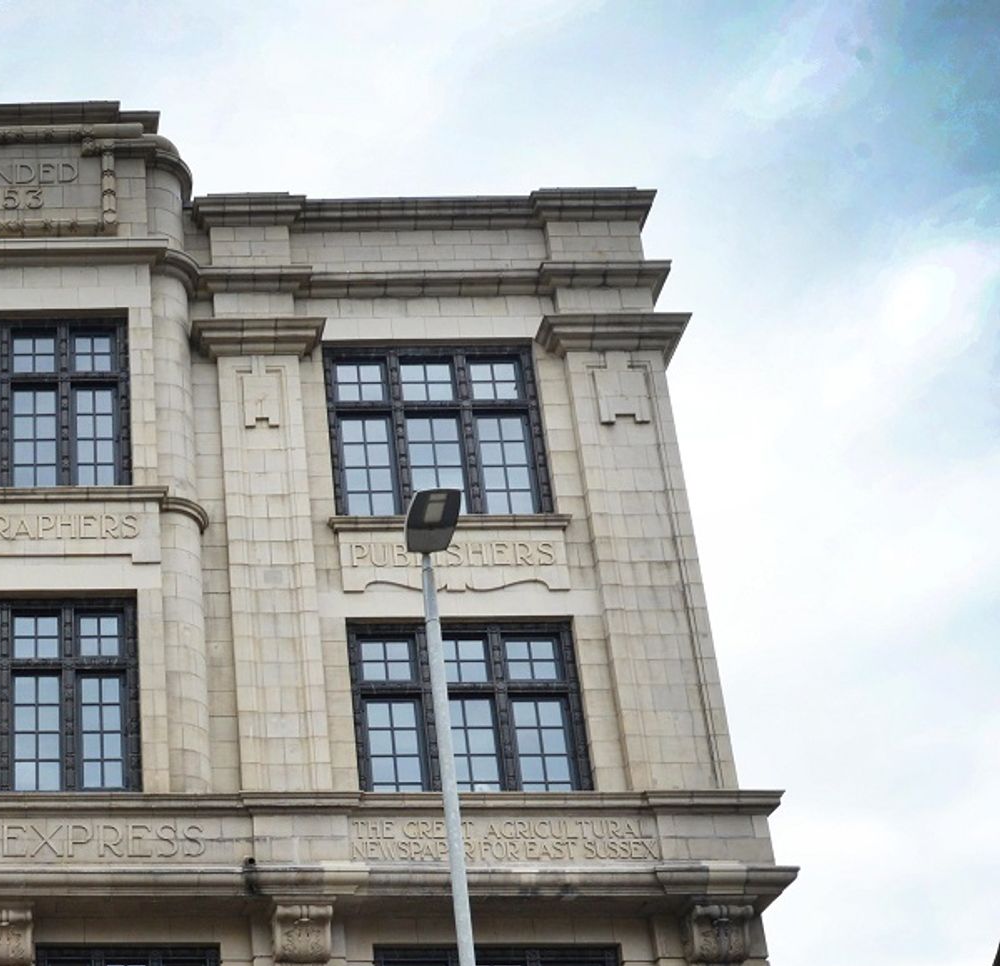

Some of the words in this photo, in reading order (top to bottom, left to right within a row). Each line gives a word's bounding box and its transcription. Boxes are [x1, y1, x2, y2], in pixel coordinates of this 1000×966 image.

[0, 824, 207, 858] EXPRESS
[352, 820, 394, 840] THE
[402, 820, 475, 840] GRET
[486, 819, 651, 841] AGRICULTURAL
[350, 840, 475, 861] NEWSPAPR
[478, 840, 520, 860] FOR
[525, 840, 579, 860] EAST
[584, 840, 659, 861] SUSSEX
